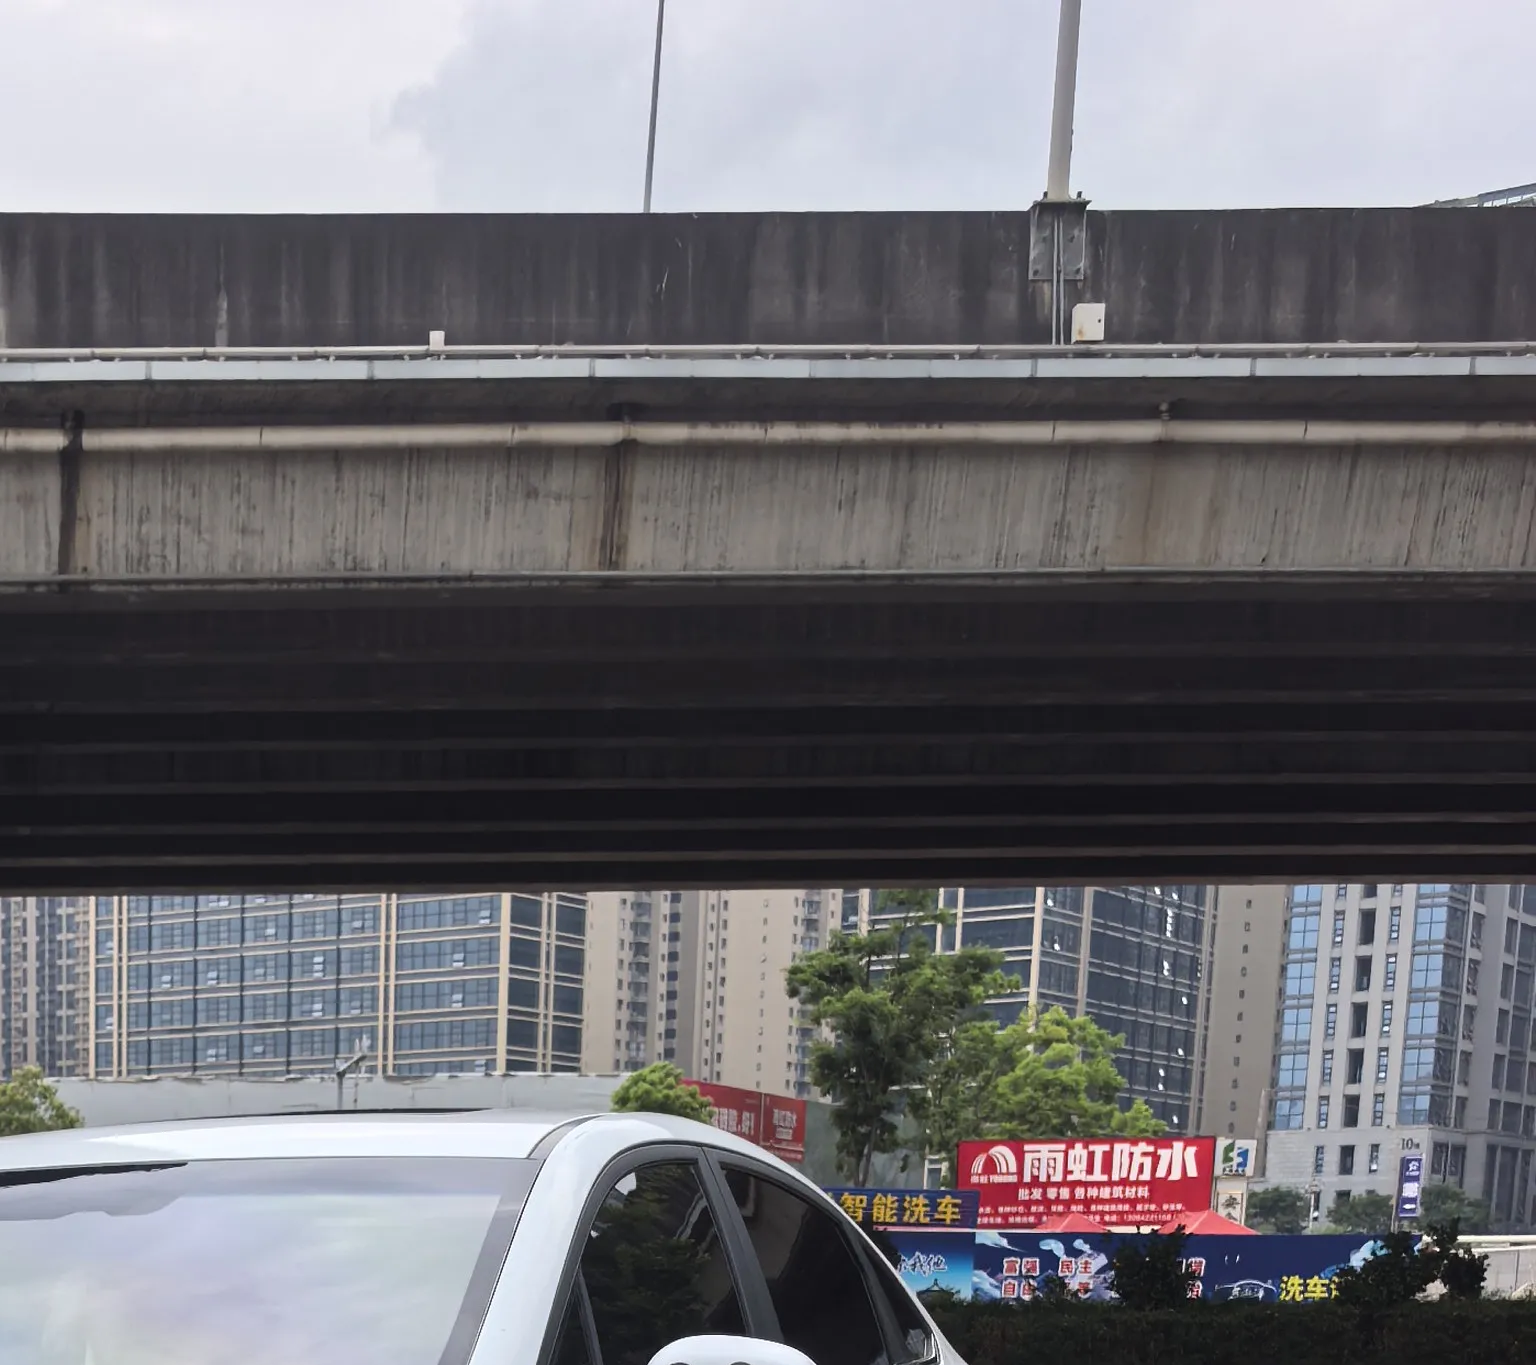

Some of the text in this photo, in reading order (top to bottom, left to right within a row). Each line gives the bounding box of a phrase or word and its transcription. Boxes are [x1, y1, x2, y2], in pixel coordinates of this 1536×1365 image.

[1023, 1141, 1198, 1183] 雨虹防水
[1018, 1188, 1042, 1200] 批发
[827, 1192, 963, 1225] 智能洗车
[1058, 1257, 1094, 1275] 民主
